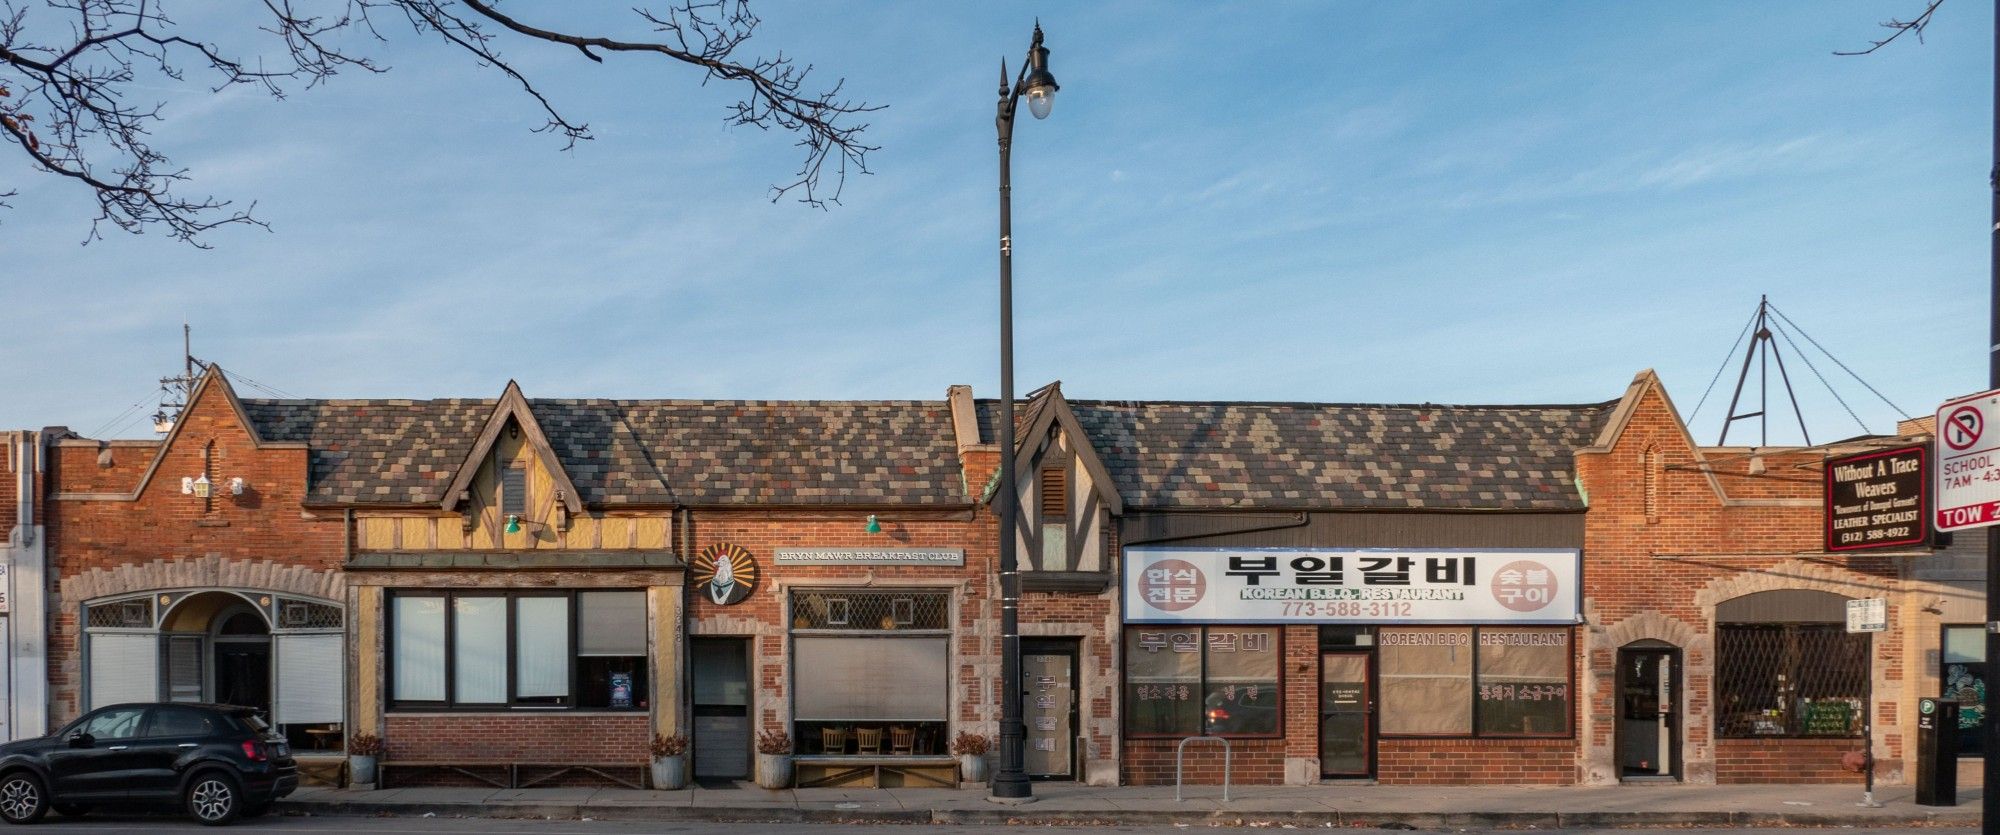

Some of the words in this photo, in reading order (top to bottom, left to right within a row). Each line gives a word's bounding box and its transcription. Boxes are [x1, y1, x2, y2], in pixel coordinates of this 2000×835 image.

[1834, 464, 1873, 482] Without
[1877, 460, 1886, 477] A
[1890, 457, 1918, 474] Trace
[1944, 455, 1994, 475] SCHOOL
[1855, 482, 1897, 498] Weavers
[1945, 475, 1972, 490] 7AM
[1834, 516, 1869, 529] LEATHER
[1872, 510, 1918, 525] SPECIALIST
[1943, 505, 1982, 526] TOW
[1841, 532, 1863, 543] (312)
[1866, 527, 1909, 540] 588-4922
[779, 552, 813, 560] BRYN
[815, 552, 853, 560] MAWR
[855, 552, 927, 560] BREAKFAST
[928, 552, 958, 560] CLUB
[1147, 568, 1197, 585] 한식
[1225, 556, 1476, 586] 부일갈비
[1499, 569, 1549, 585] 숯불
[1147, 587, 1198, 603] 전문
[1241, 588, 1308, 600] KOREAN
[1360, 588, 1464, 600] RESTAURANT
[1499, 588, 1549, 604] 구이
[1281, 602, 1412, 617] 773-588-3112
[1380, 632, 1435, 646] KOREAN
[1480, 632, 1567, 646] RESTAURANT
[1519, 685, 1567, 701] 소금구이
